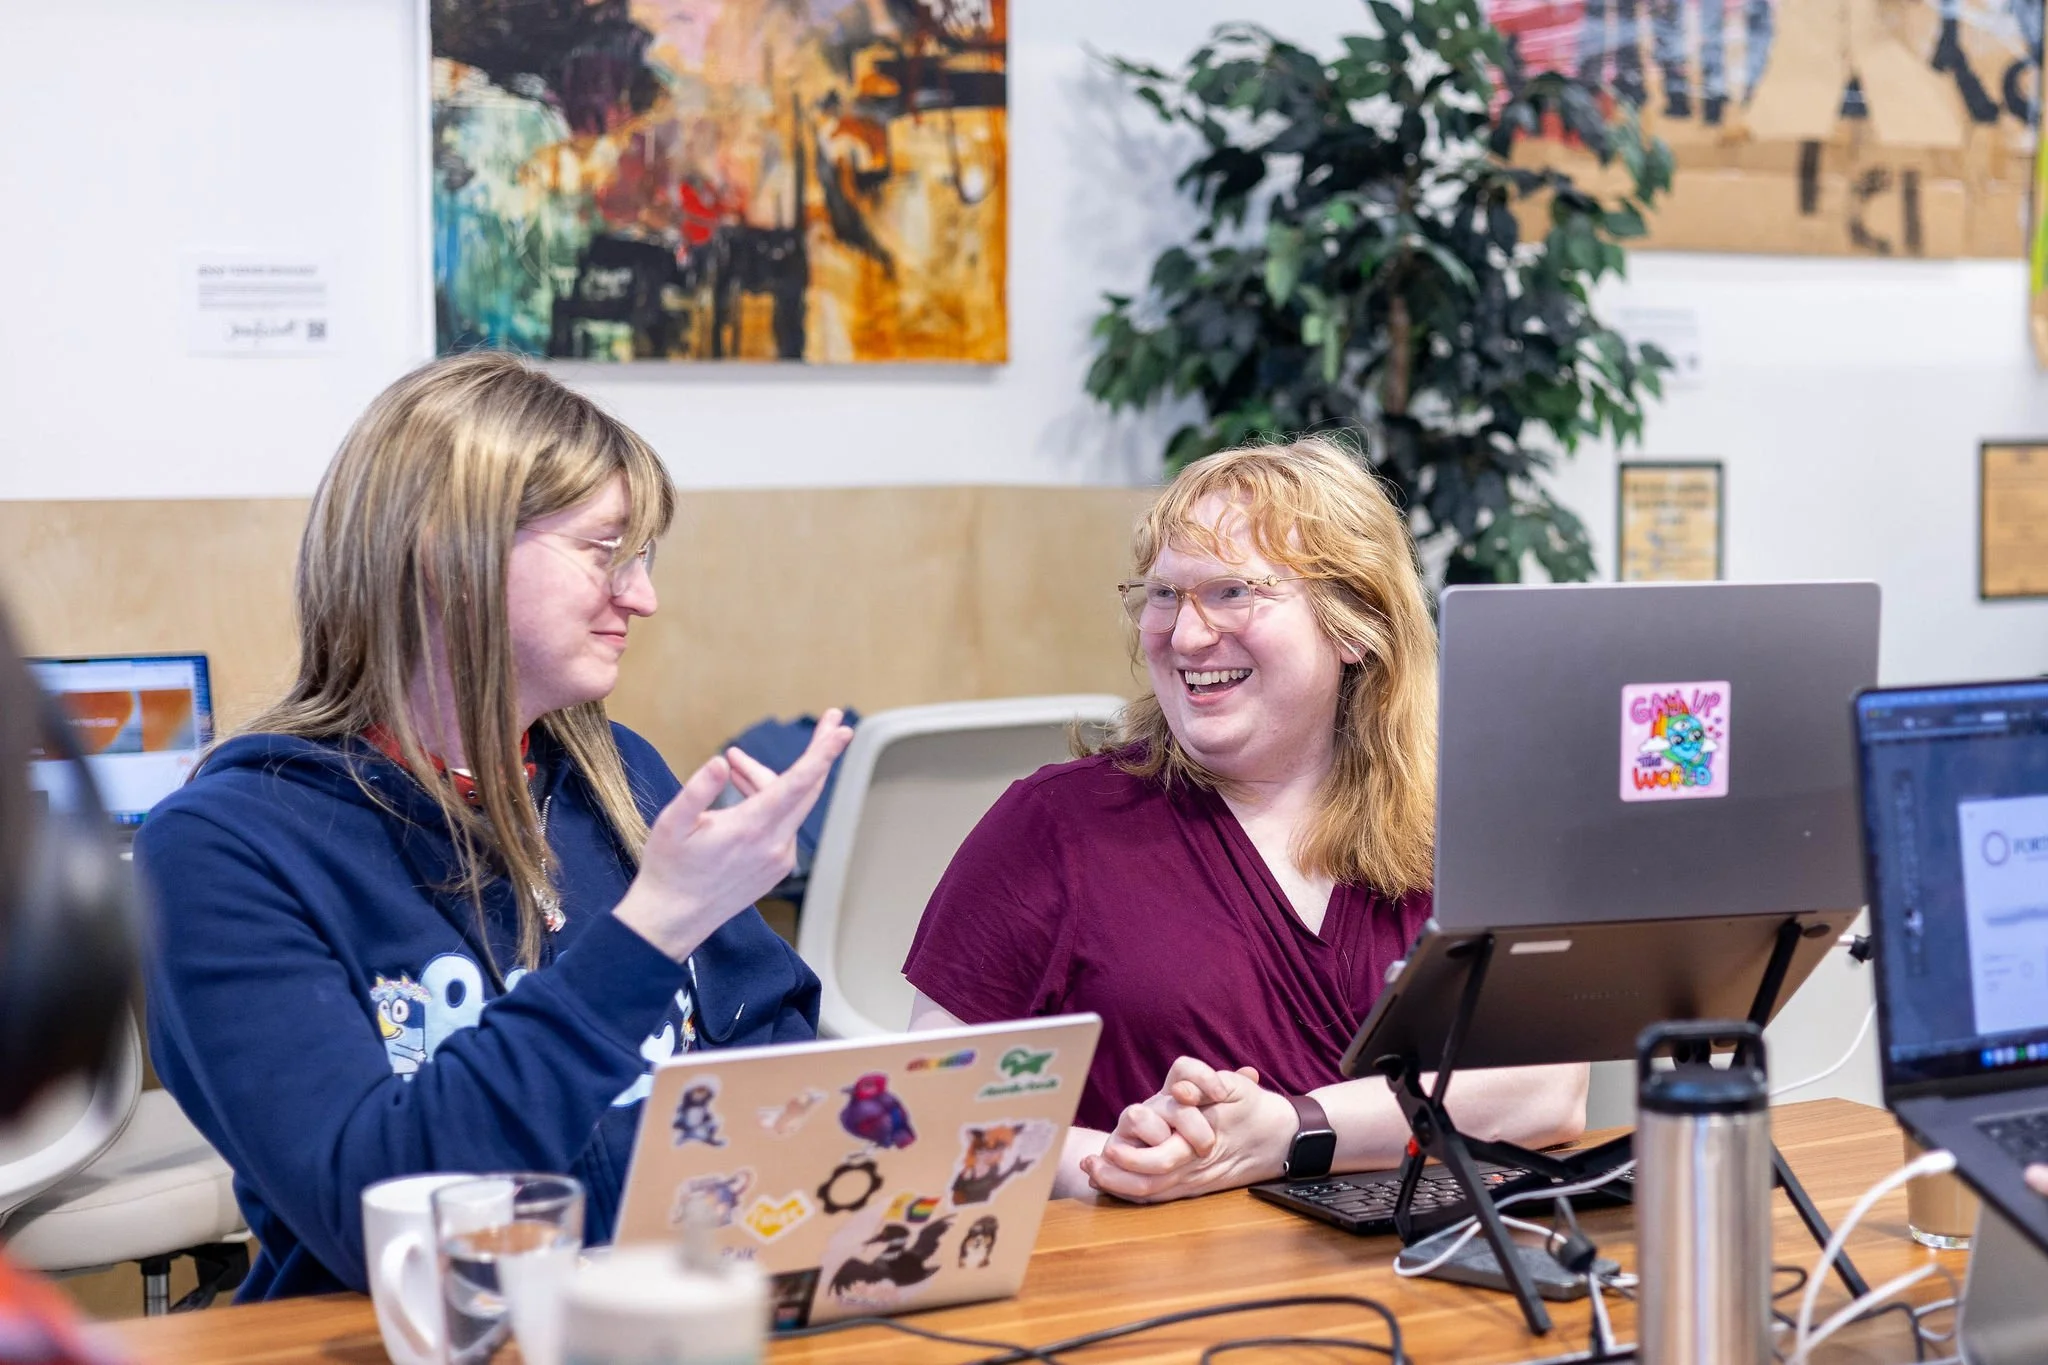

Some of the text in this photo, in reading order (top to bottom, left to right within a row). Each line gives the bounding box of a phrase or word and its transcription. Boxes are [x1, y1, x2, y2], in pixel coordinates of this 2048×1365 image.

[1630, 689, 1721, 724] GAY UP
[1632, 764, 1712, 790] WORLD
